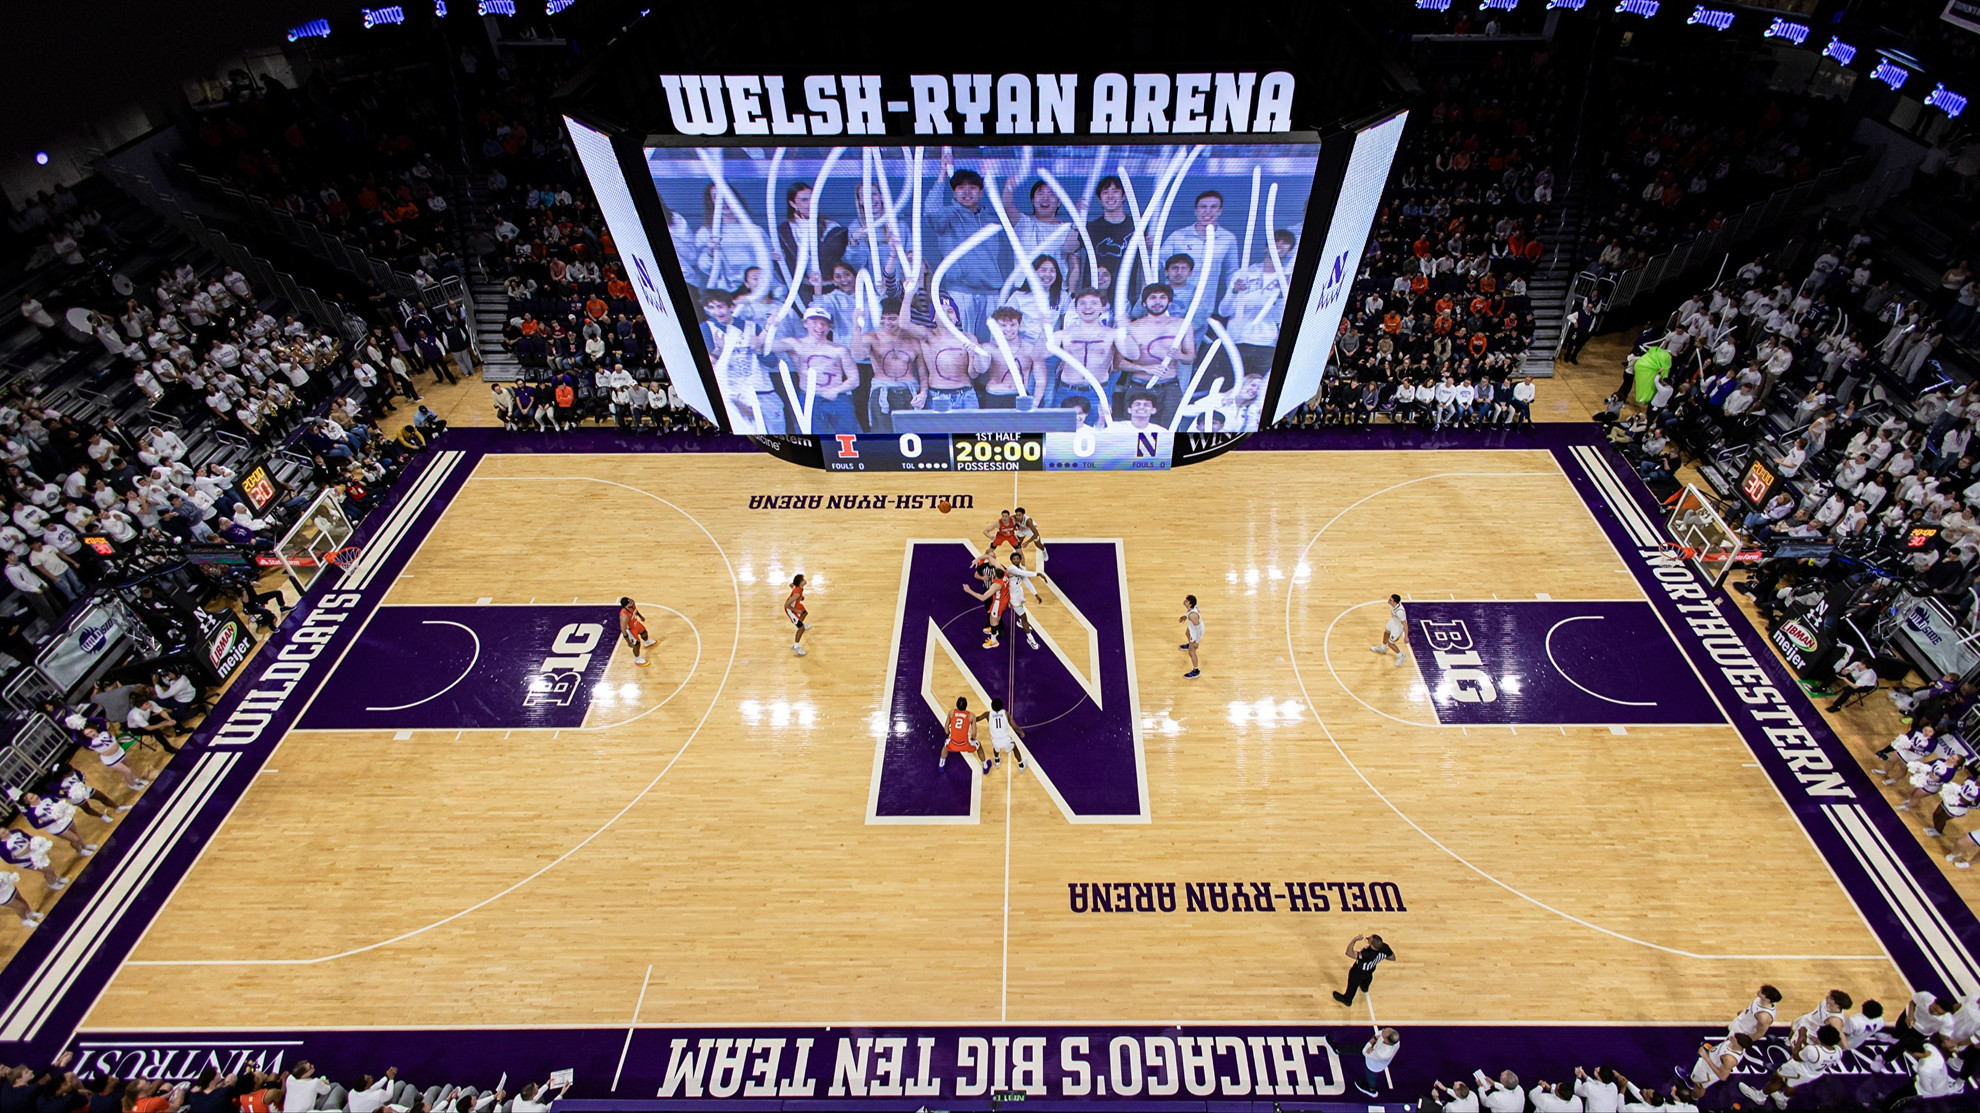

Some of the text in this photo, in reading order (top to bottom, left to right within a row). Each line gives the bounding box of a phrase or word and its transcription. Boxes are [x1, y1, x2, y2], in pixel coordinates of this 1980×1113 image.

[659, 71, 1296, 135] WELSH-RYAN ARENA
[899, 433, 922, 458] 0
[975, 432, 1021, 442] 1ST HALF
[1073, 433, 1096, 458] 0
[1136, 432, 1159, 458] N
[955, 440, 1041, 462] 20:00
[957, 461, 1019, 471] POSSESSION
[1159, 461, 1166, 469] 0
[1752, 460, 1775, 486] 20:00
[241, 466, 265, 493] 20:00
[250, 479, 274, 507] 30
[1744, 473, 1766, 502] 30
[748, 494, 974, 510] WELSH-RYAN ARENA
[209, 624, 234, 669] LIBMAN
[1781, 619, 1815, 648] LIBMAN
[218, 637, 251, 679] meijer
[1773, 630, 1806, 670] meijer
[208, 593, 361, 747] WILDCATS
[1639, 549, 1858, 798] NORTHWESTERN
[955, 718, 963, 729] 2
[996, 718, 1002, 728] 11
[1068, 882, 1407, 913] WELSH-RYAN ARENA
[656, 1036, 1345, 1098] CHICAGO'S BIG TEN TEAM
